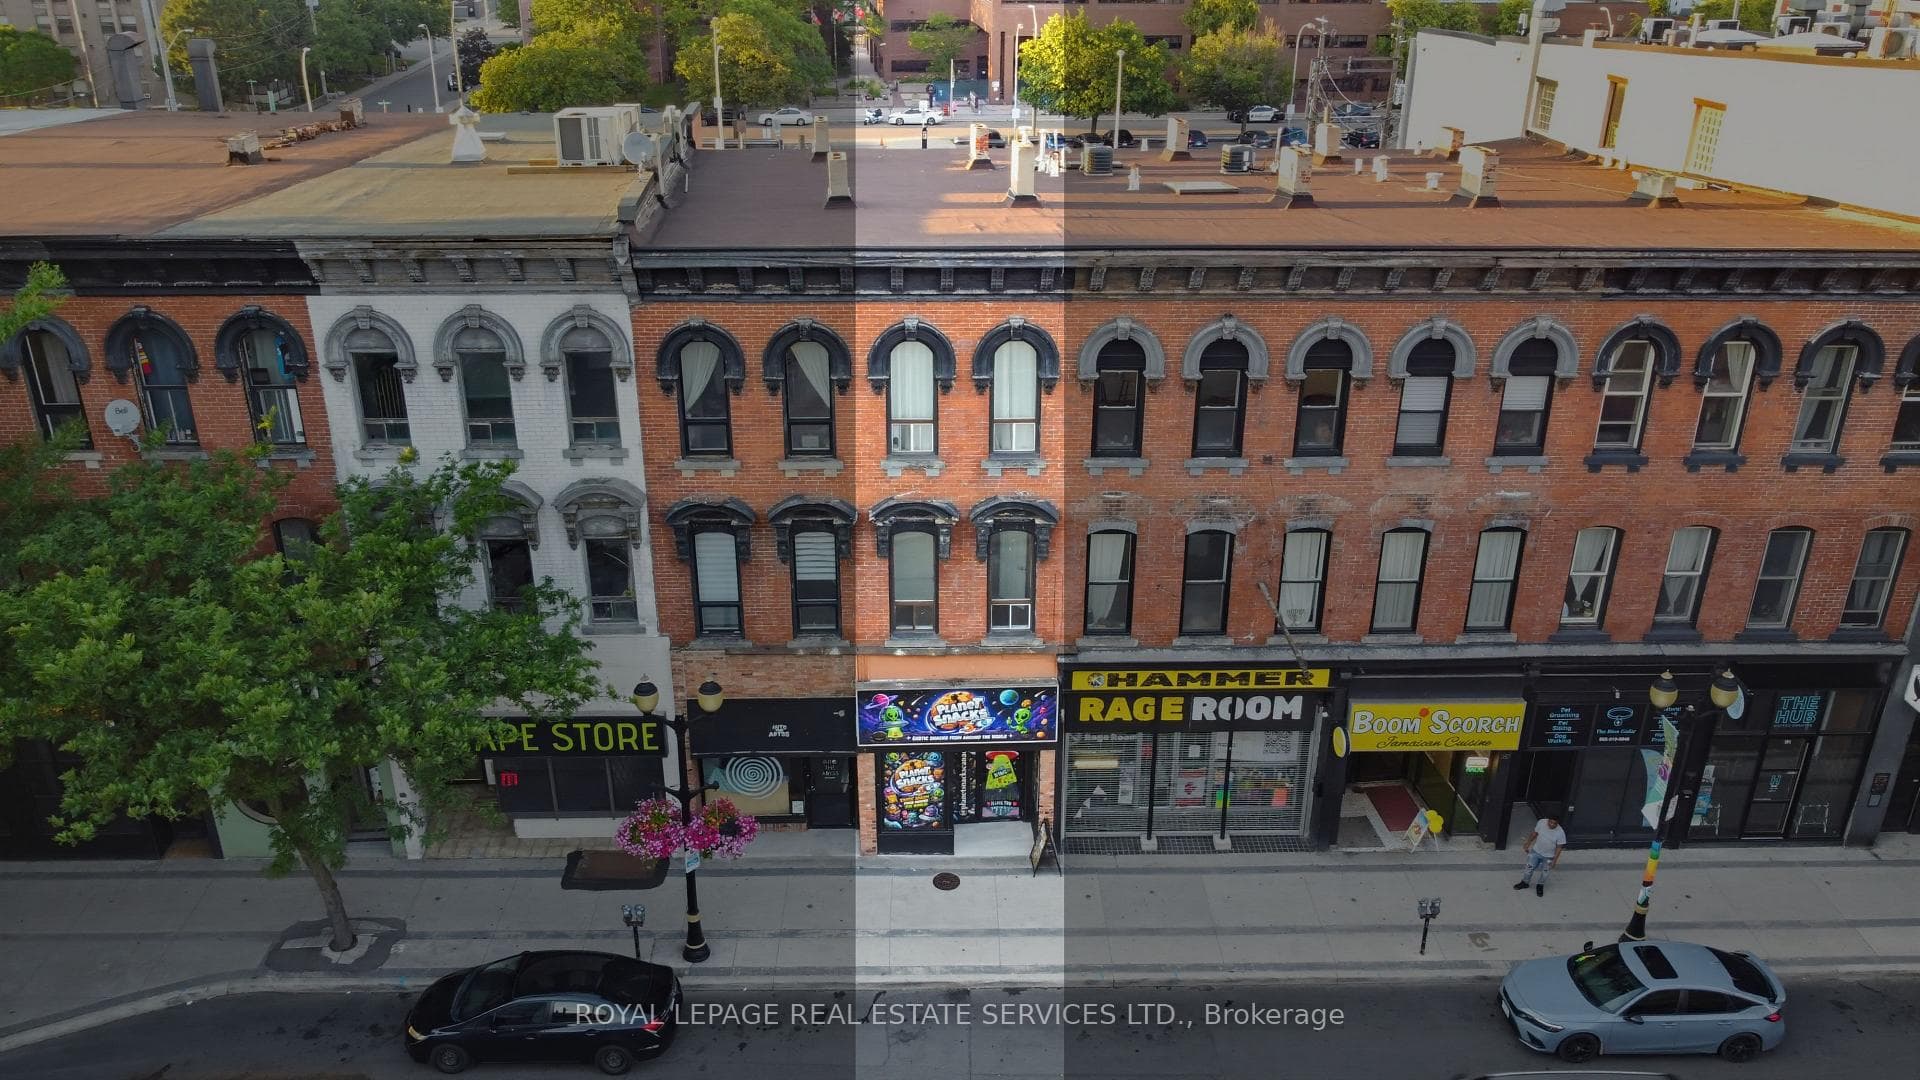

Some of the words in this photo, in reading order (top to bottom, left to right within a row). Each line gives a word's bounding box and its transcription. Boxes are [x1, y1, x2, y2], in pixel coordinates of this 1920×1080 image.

[1106, 671, 1314, 687] HAMMER
[1079, 696, 1185, 722] RAGE
[1191, 695, 1303, 721] ROOM
[1779, 695, 1821, 710] THE
[1775, 709, 1817, 724] HUB
[475, 723, 539, 752] APE
[551, 722, 660, 752] STORE
[1376, 736, 1441, 749] Jamaican
[1444, 736, 1492, 748] Cuisine
